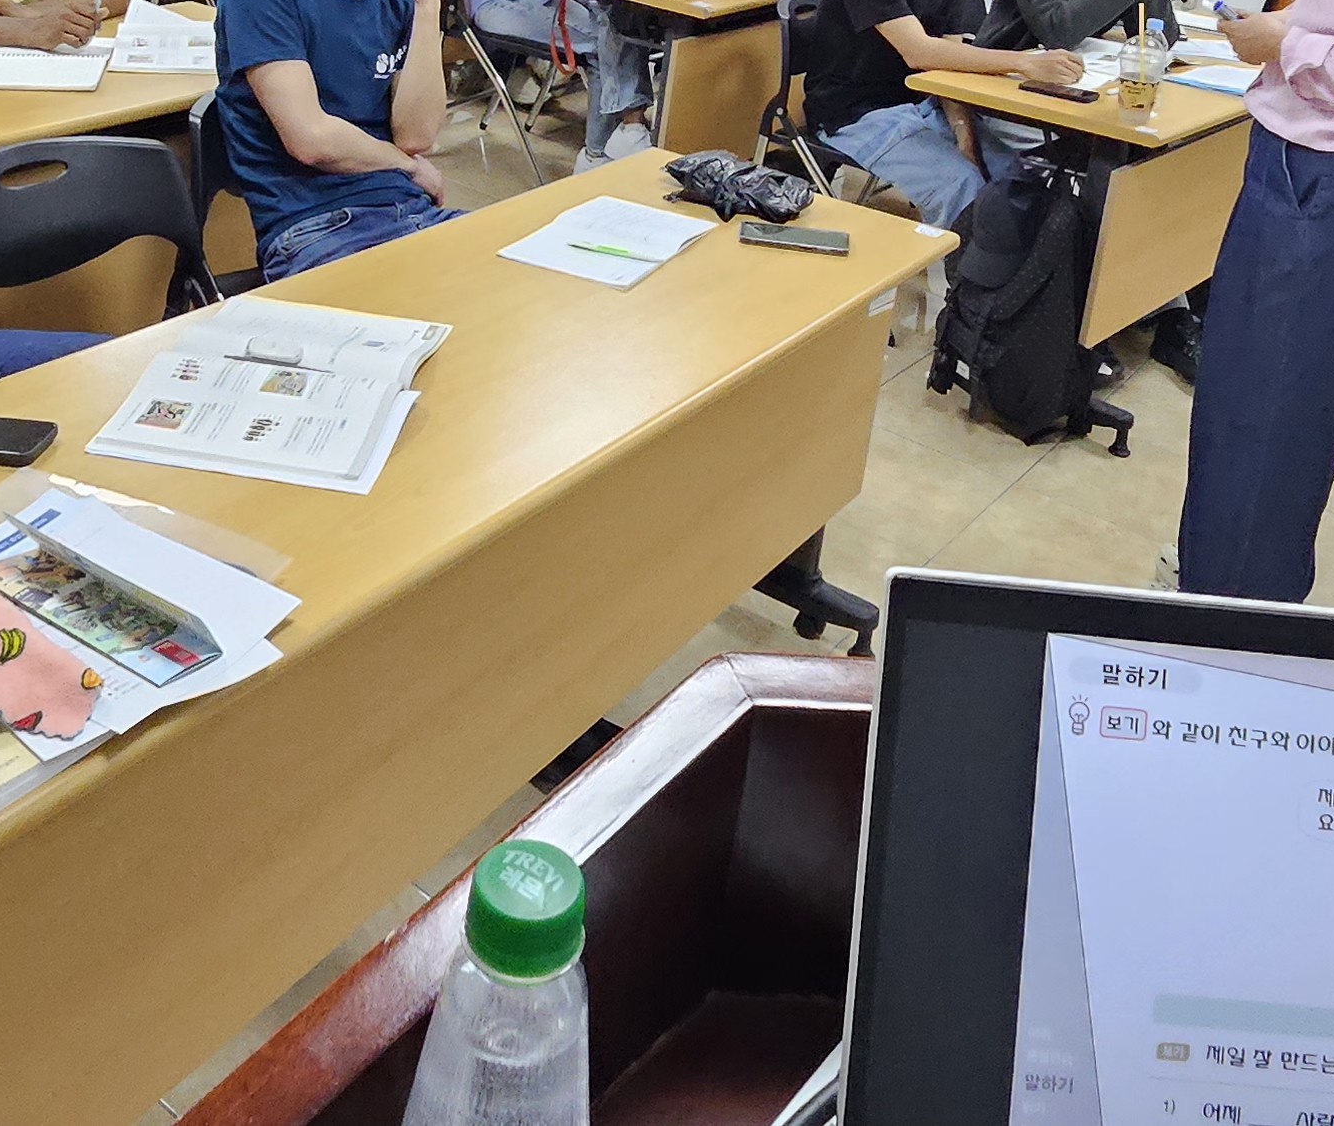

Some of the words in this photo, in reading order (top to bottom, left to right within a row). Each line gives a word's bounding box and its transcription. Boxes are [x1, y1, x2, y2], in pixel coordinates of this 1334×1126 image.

[1102, 663, 1168, 690] 말하기
[1107, 715, 1140, 735] 보기
[1152, 720, 1172, 740] 와
[1180, 722, 1220, 745] 같이
[1228, 726, 1291, 752] 친구와
[499, 865, 543, 901] 레몬
[502, 850, 565, 892] TREVI
[1206, 1044, 1246, 1068] 제일
[1253, 1048, 1272, 1070] 잘
[1025, 1074, 1075, 1094] 말하기
[1203, 1103, 1242, 1124] 어제
